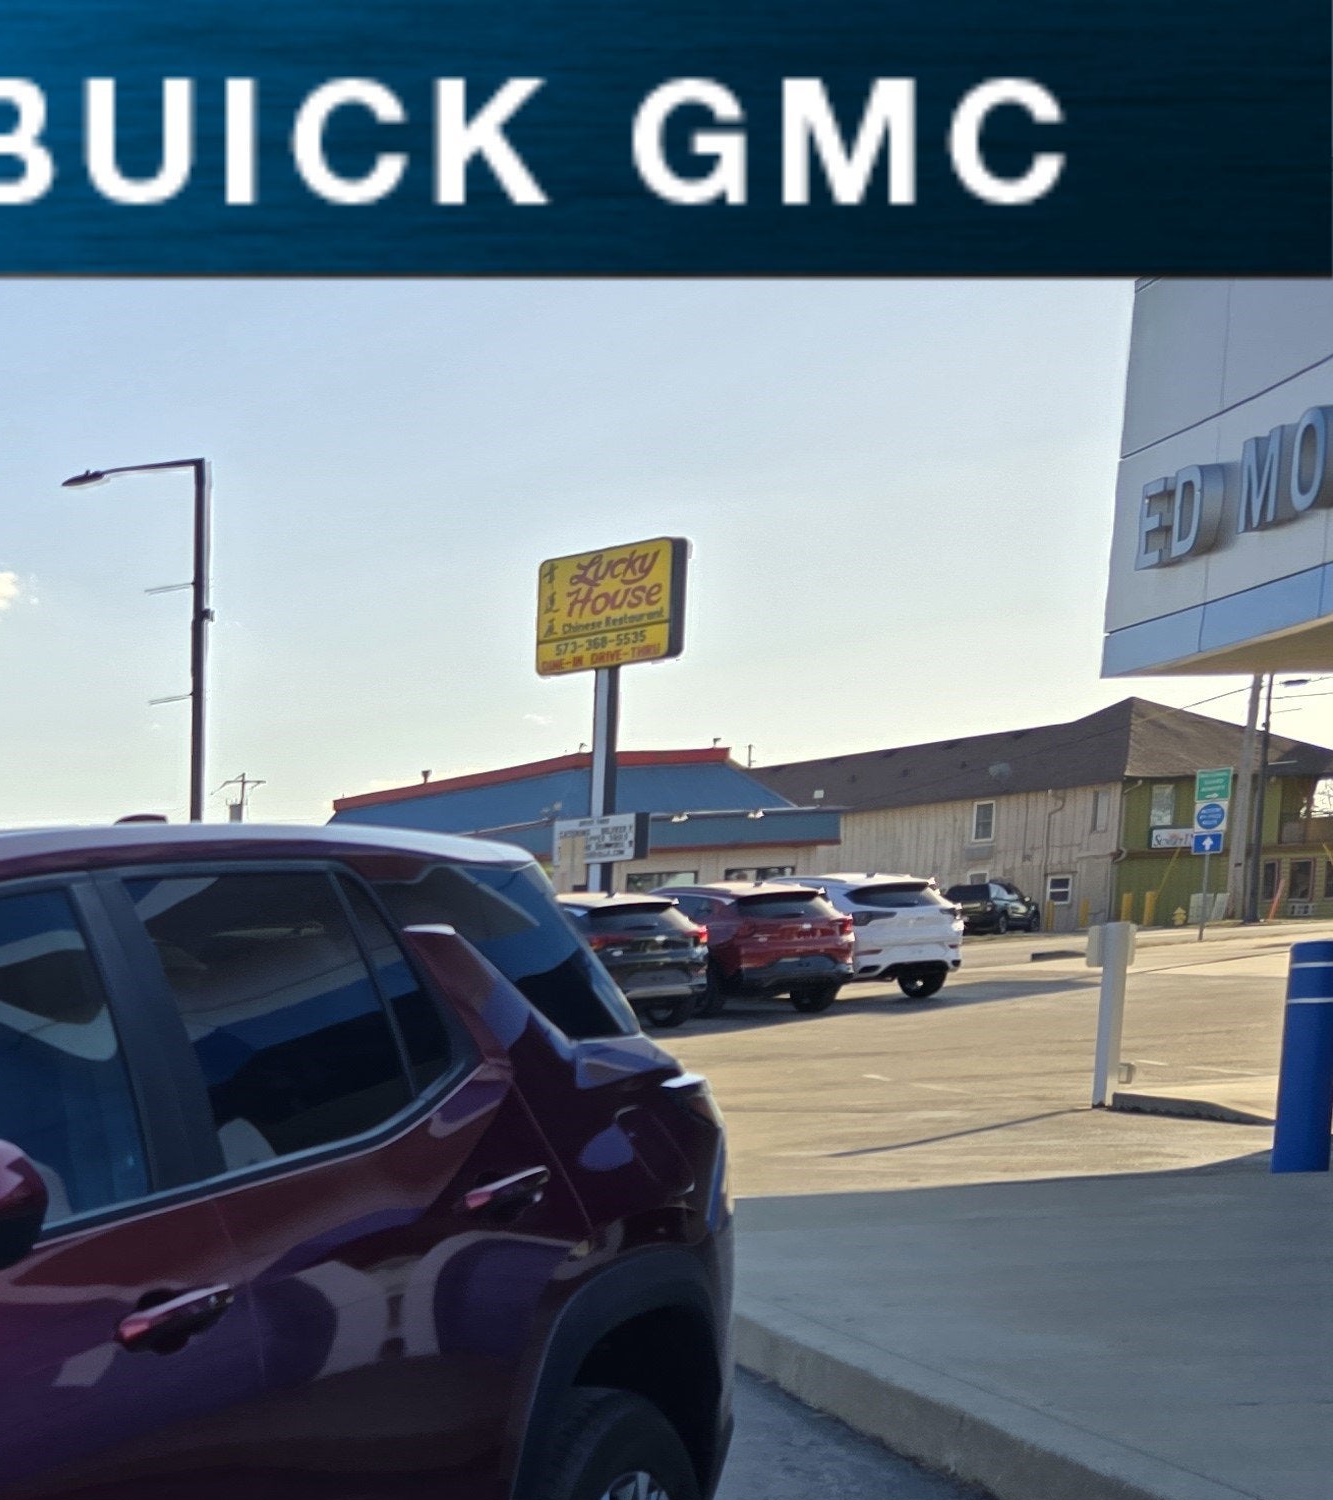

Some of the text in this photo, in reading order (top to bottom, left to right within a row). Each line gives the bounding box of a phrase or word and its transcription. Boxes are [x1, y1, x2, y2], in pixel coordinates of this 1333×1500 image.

[1135, 463, 1219, 571] ED
[570, 549, 661, 586] Lucky
[566, 582, 663, 618] House
[563, 608, 663, 634] Chinese Restaurant
